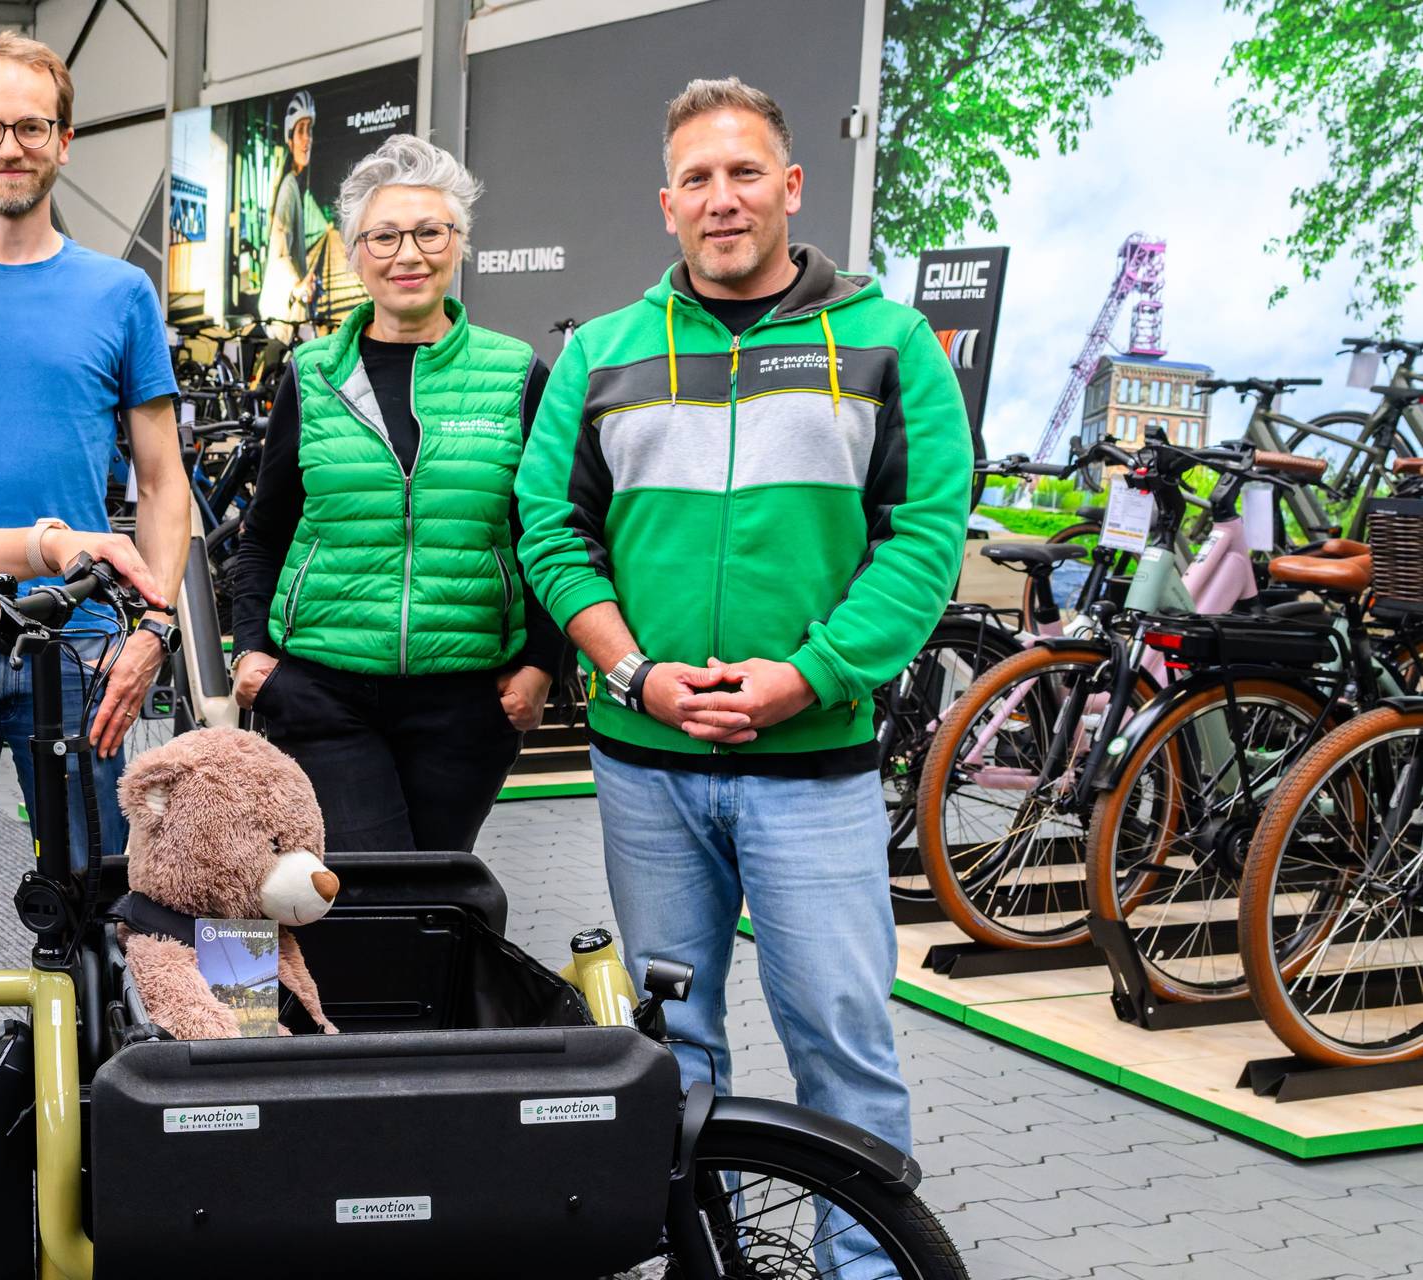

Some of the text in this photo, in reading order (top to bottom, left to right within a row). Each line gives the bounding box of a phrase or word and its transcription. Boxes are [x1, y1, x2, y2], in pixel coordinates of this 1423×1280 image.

[478, 246, 565, 274] BERATUNG
[924, 260, 991, 289] QWIC
[922, 288, 986, 301] RIDE YOUR STYLE
[760, 366, 773, 374] DIE
[217, 930, 274, 939] STADTRADELN
[536, 1100, 600, 1115] e-motion
[179, 1109, 244, 1123] e-motion
[351, 1200, 416, 1214] e-motion
